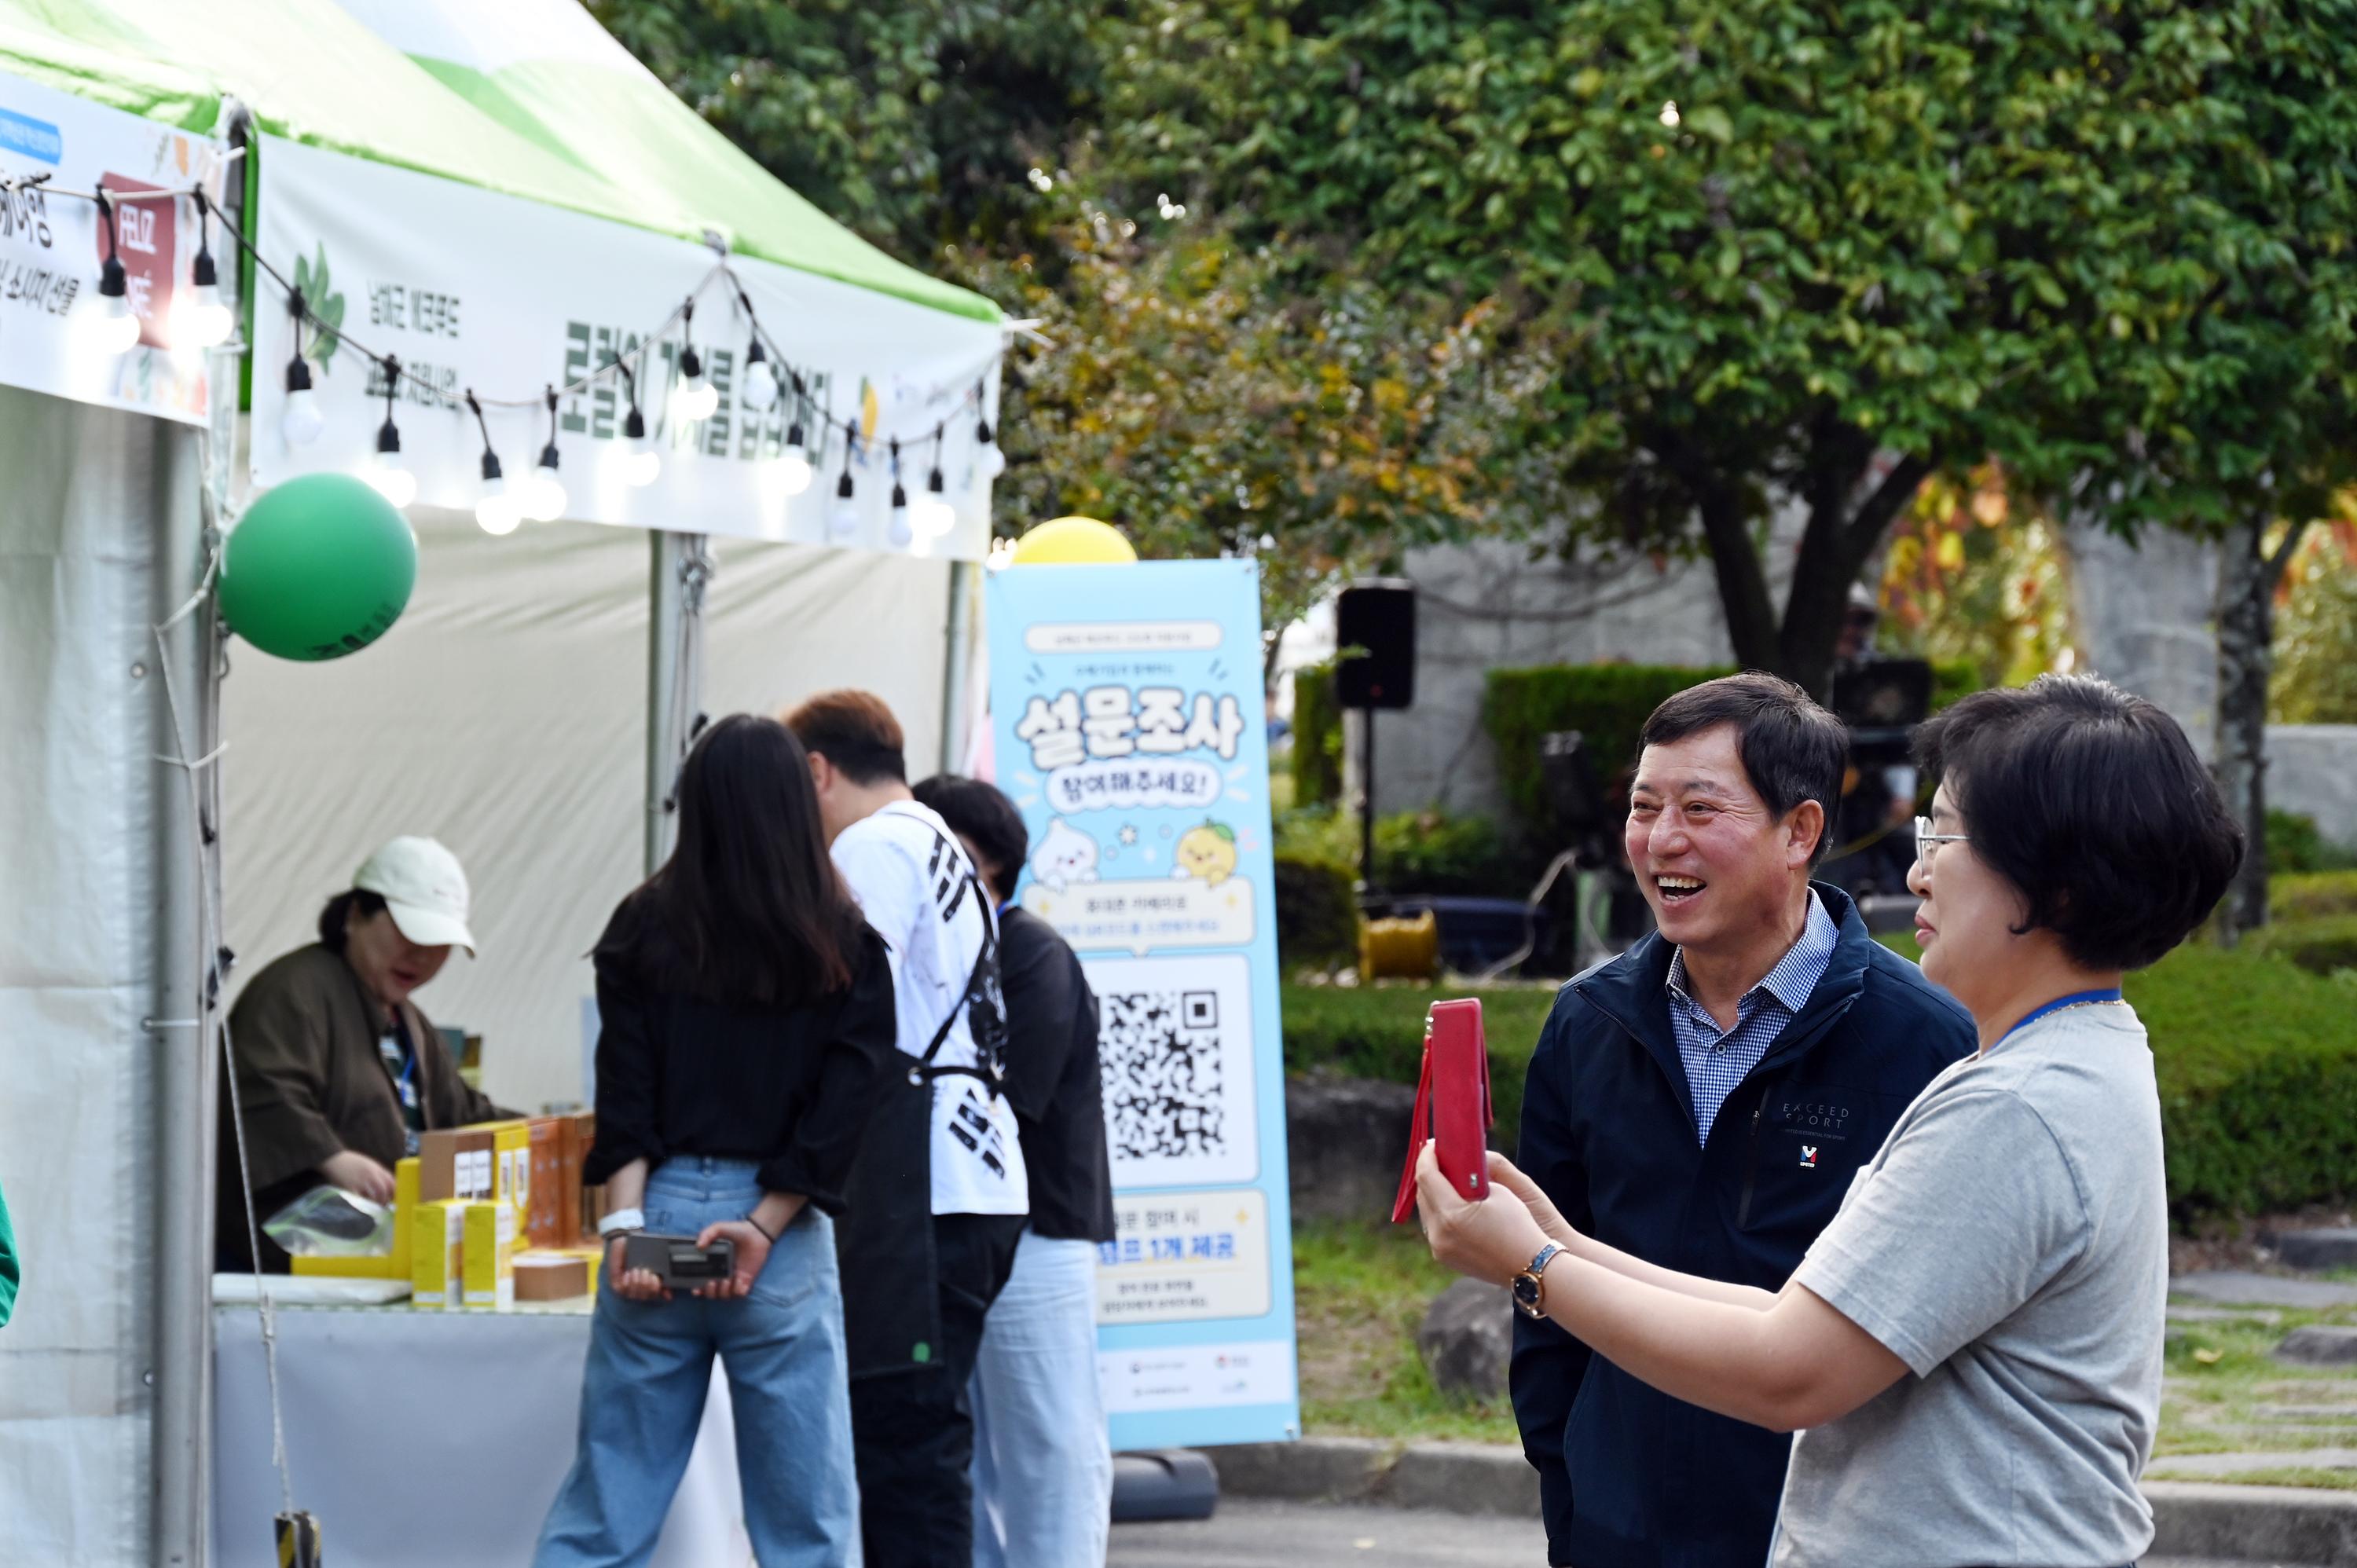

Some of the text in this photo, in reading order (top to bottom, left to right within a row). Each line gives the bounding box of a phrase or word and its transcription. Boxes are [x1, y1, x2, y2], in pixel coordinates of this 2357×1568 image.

[1015, 685, 1245, 771] 설문조사
[1062, 771, 1207, 803] 참여해주세요!
[1783, 1103, 1849, 1118] EXCEED
[1099, 1233, 1233, 1266] 탬프 1개 제공
